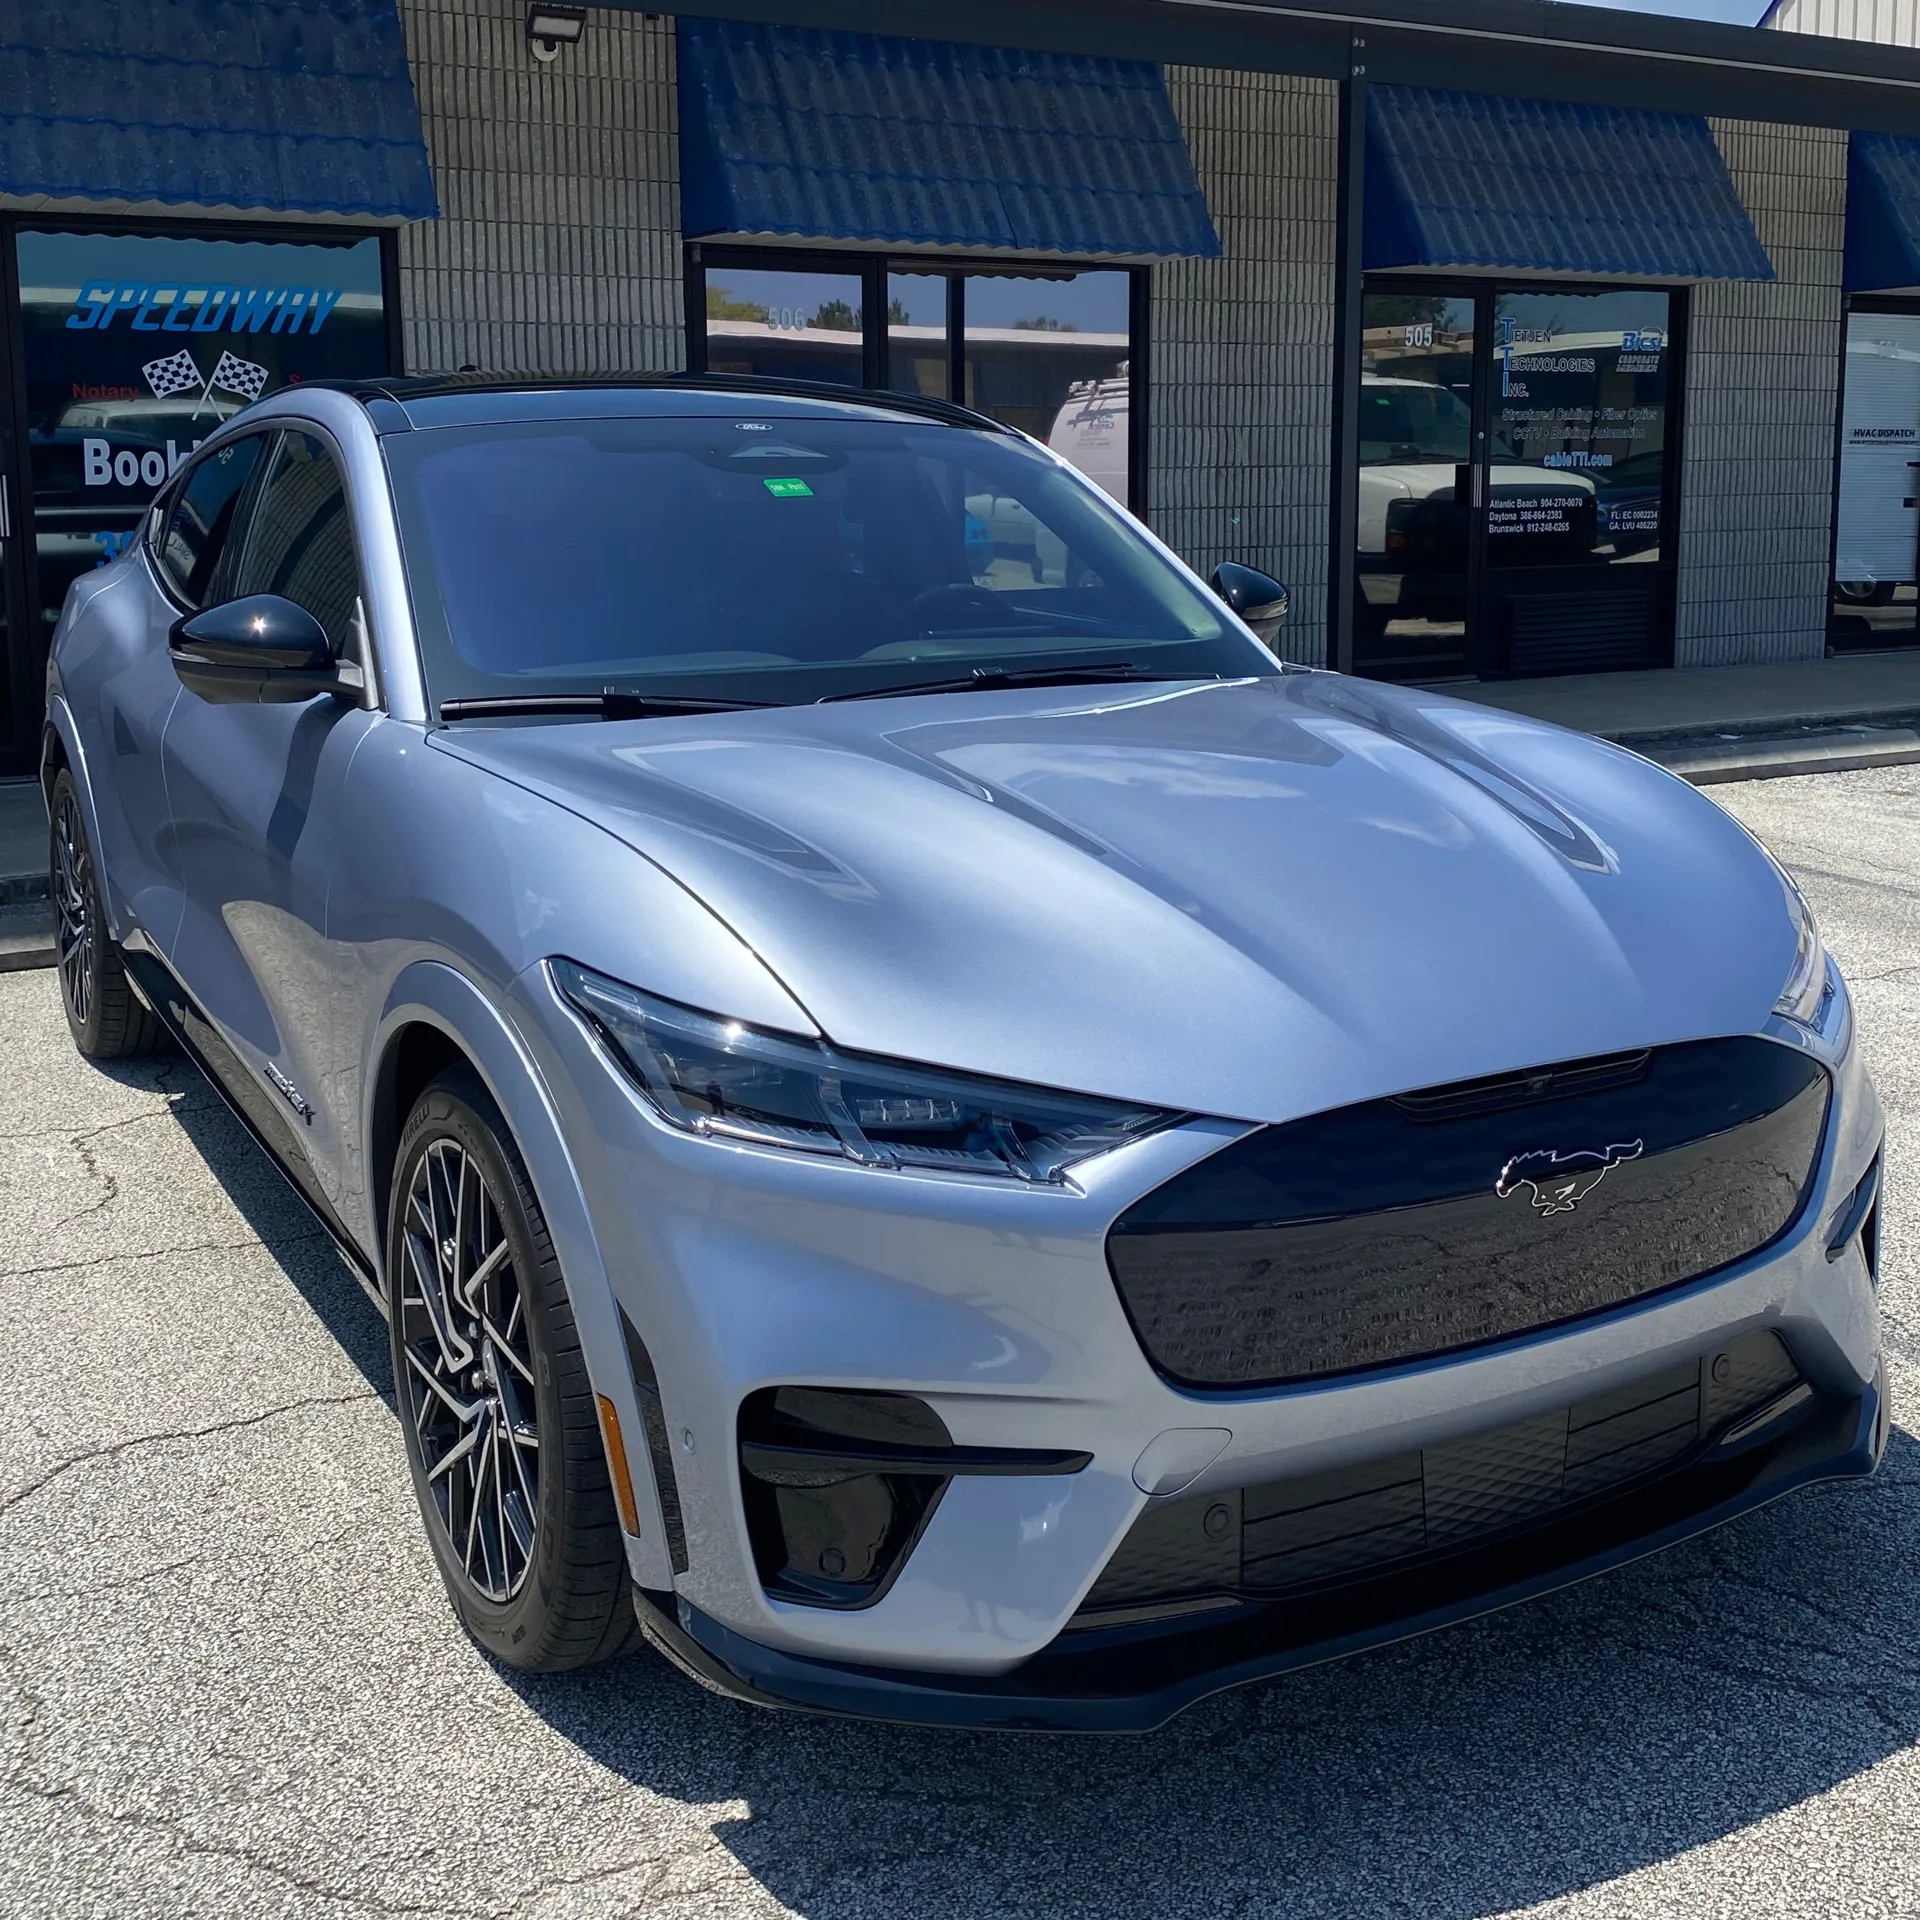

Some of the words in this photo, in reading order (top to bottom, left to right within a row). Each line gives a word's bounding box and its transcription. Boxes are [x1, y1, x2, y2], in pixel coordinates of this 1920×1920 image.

[65, 280, 343, 334] SPEEDWAY
[767, 306, 805, 331] 506
[1405, 326, 1432, 347] 505
[1500, 346, 1596, 372] TECHNOLOGIES
[72, 384, 140, 403] Notary
[1502, 408, 1555, 421] Structured
[1556, 408, 1593, 423] Cabling
[1513, 427, 1543, 440] CCTV
[1551, 427, 1591, 441] Building
[1591, 427, 1646, 439] Automation
[1854, 429, 1877, 437] HVAC
[1878, 429, 1915, 437] DISPATCH
[83, 438, 201, 486] Book
[1489, 499, 1515, 508] Atlantic
[1517, 499, 1538, 508] Beach
[1489, 511, 1517, 522] Daytona
[1622, 511, 1632, 519] EC
[1488, 524, 1524, 533] Brunswick
